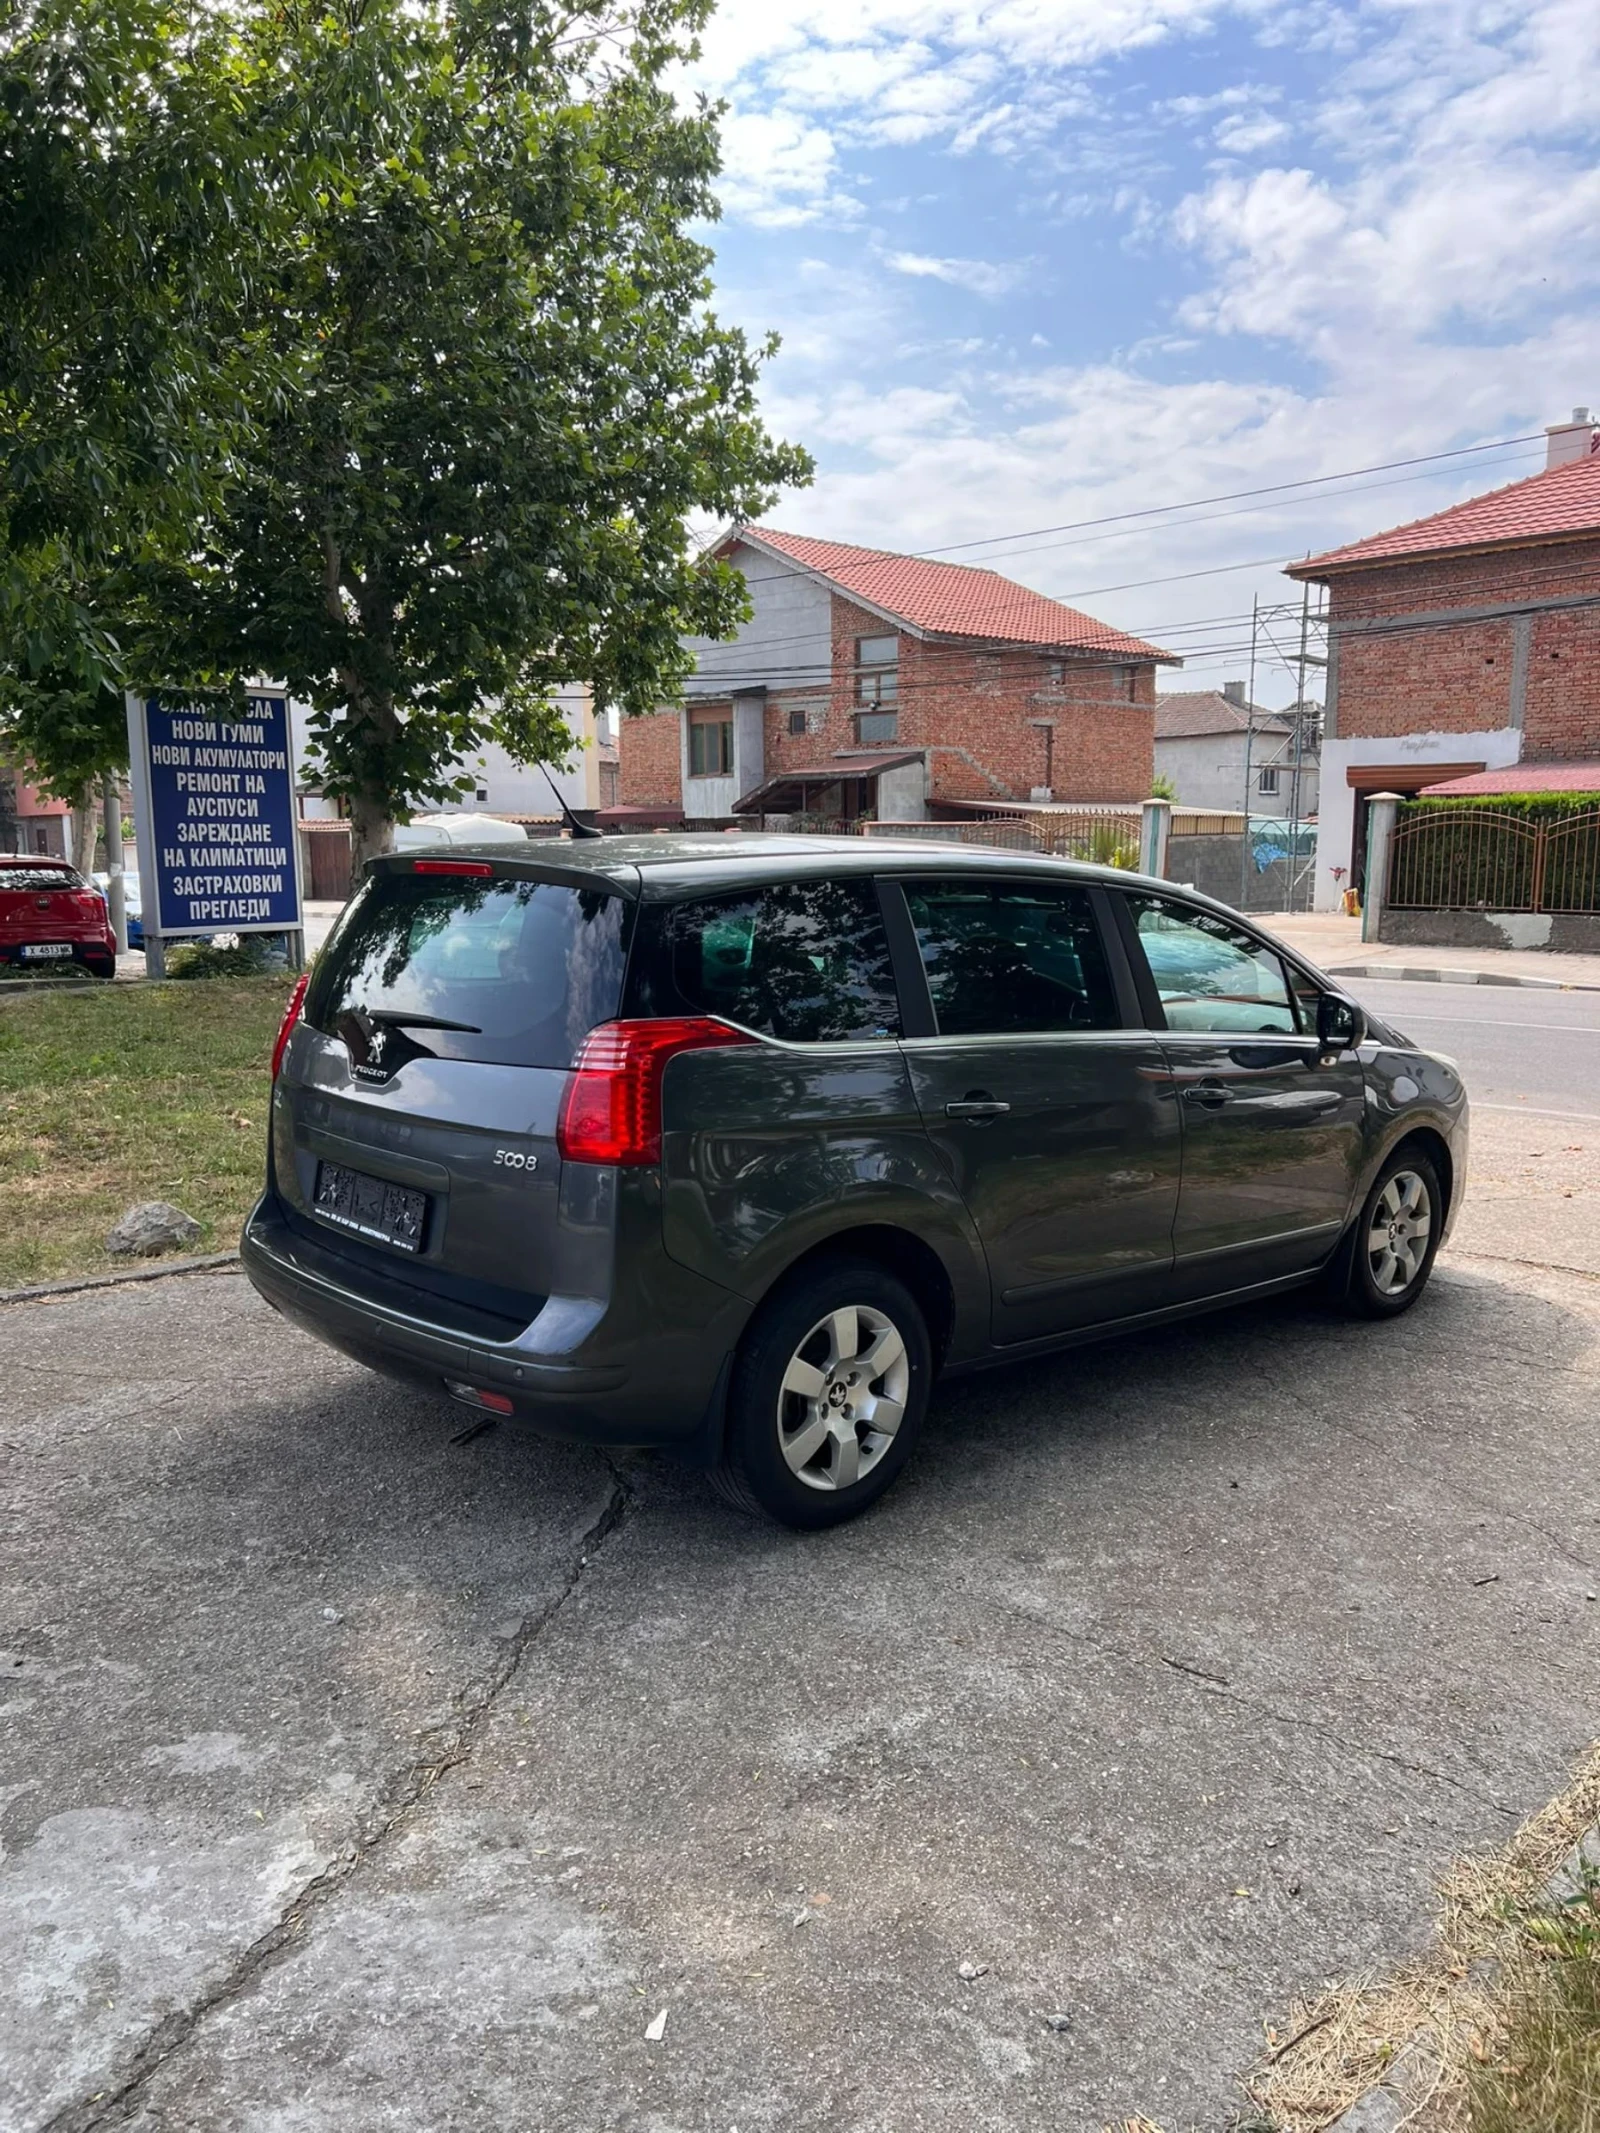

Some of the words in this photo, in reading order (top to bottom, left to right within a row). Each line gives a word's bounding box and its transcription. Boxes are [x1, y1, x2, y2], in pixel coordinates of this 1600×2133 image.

[172, 720, 217, 741] НОВИ
[221, 723, 264, 744] ГУМИ
[152, 745, 190, 765] НОВИ
[194, 748, 286, 770] АКУМУЛАТОРИ
[176, 773, 240, 793] РЕМОНТ
[246, 775, 266, 794] НА
[187, 797, 259, 817] АУСПУСИ
[177, 822, 272, 846] ЗАРЕЖДАНЕ
[164, 848, 186, 868] НА
[191, 848, 287, 870] КЛИМАТИЦИ
[173, 874, 283, 896] ЗАСТРАХОВКИ
[190, 898, 270, 921] ПРЕГЛЕДИ
[355, 1064, 388, 1079] PEUGEOT
[493, 1149, 538, 1171] 5008
